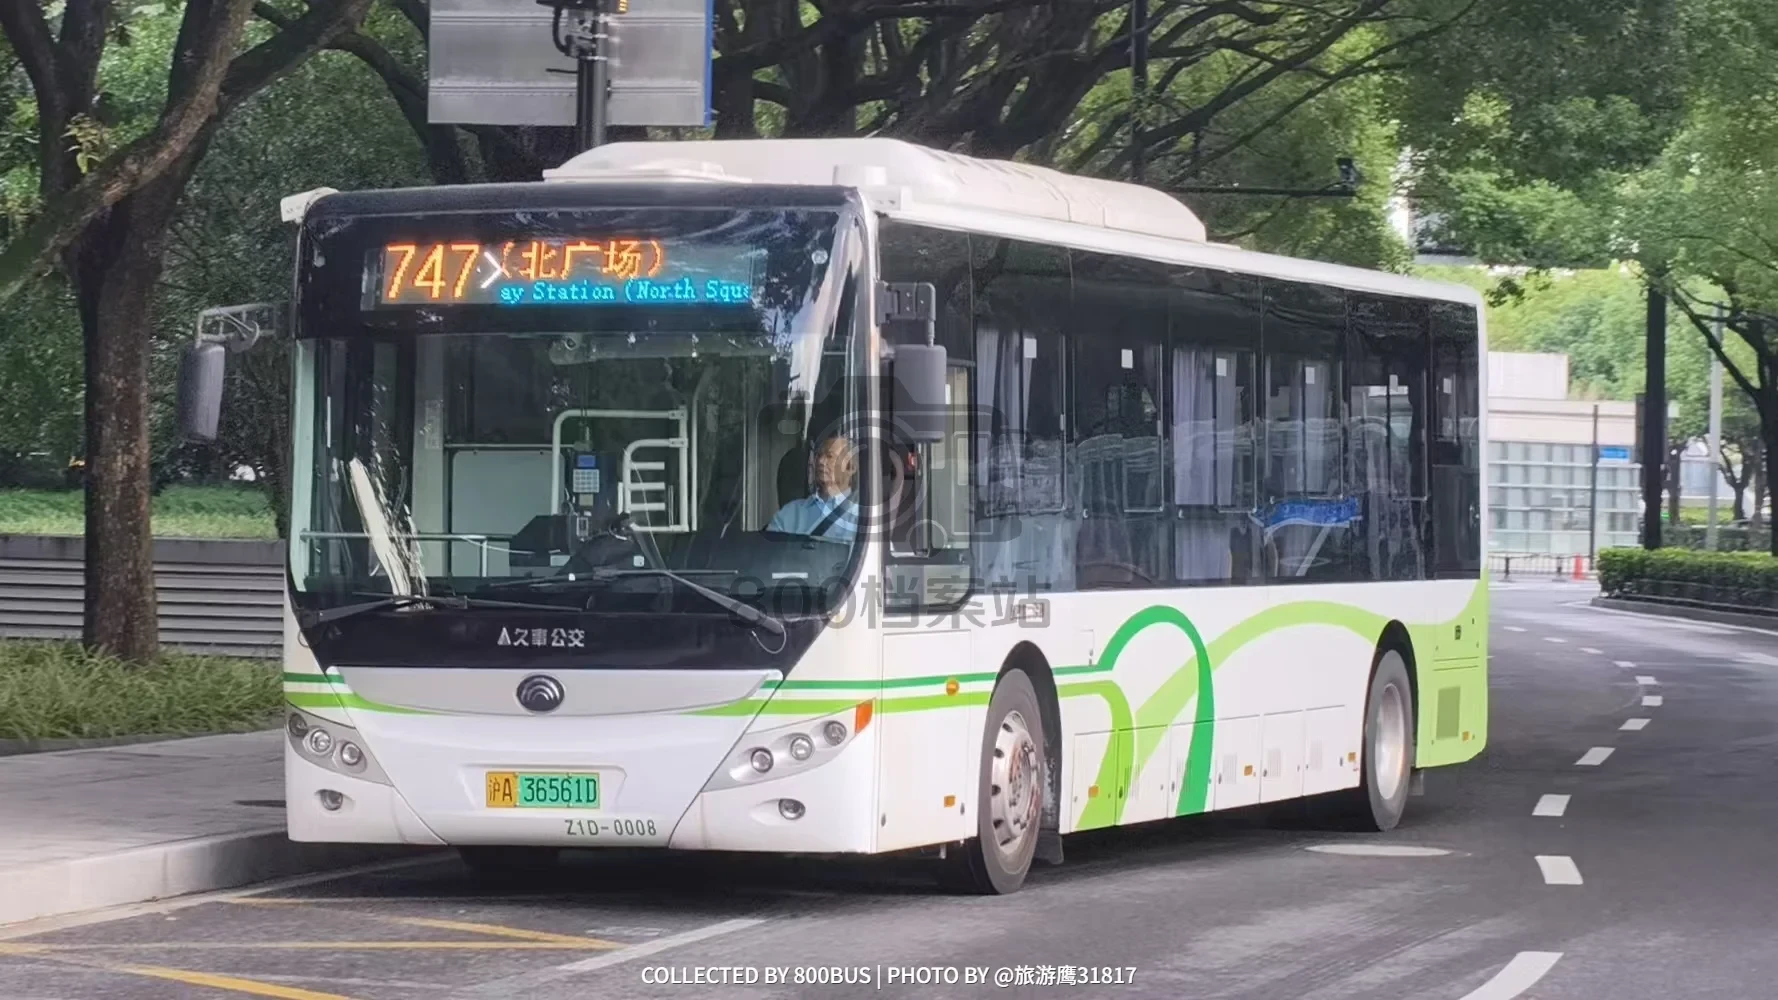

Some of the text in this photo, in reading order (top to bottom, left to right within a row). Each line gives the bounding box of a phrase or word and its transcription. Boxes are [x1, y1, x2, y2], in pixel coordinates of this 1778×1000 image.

[386, 242, 481, 300] 747
[532, 280, 615, 300] Station
[625, 277, 696, 301] (North
[523, 777, 597, 803] 36561D
[564, 819, 657, 836] Z1D-0008
